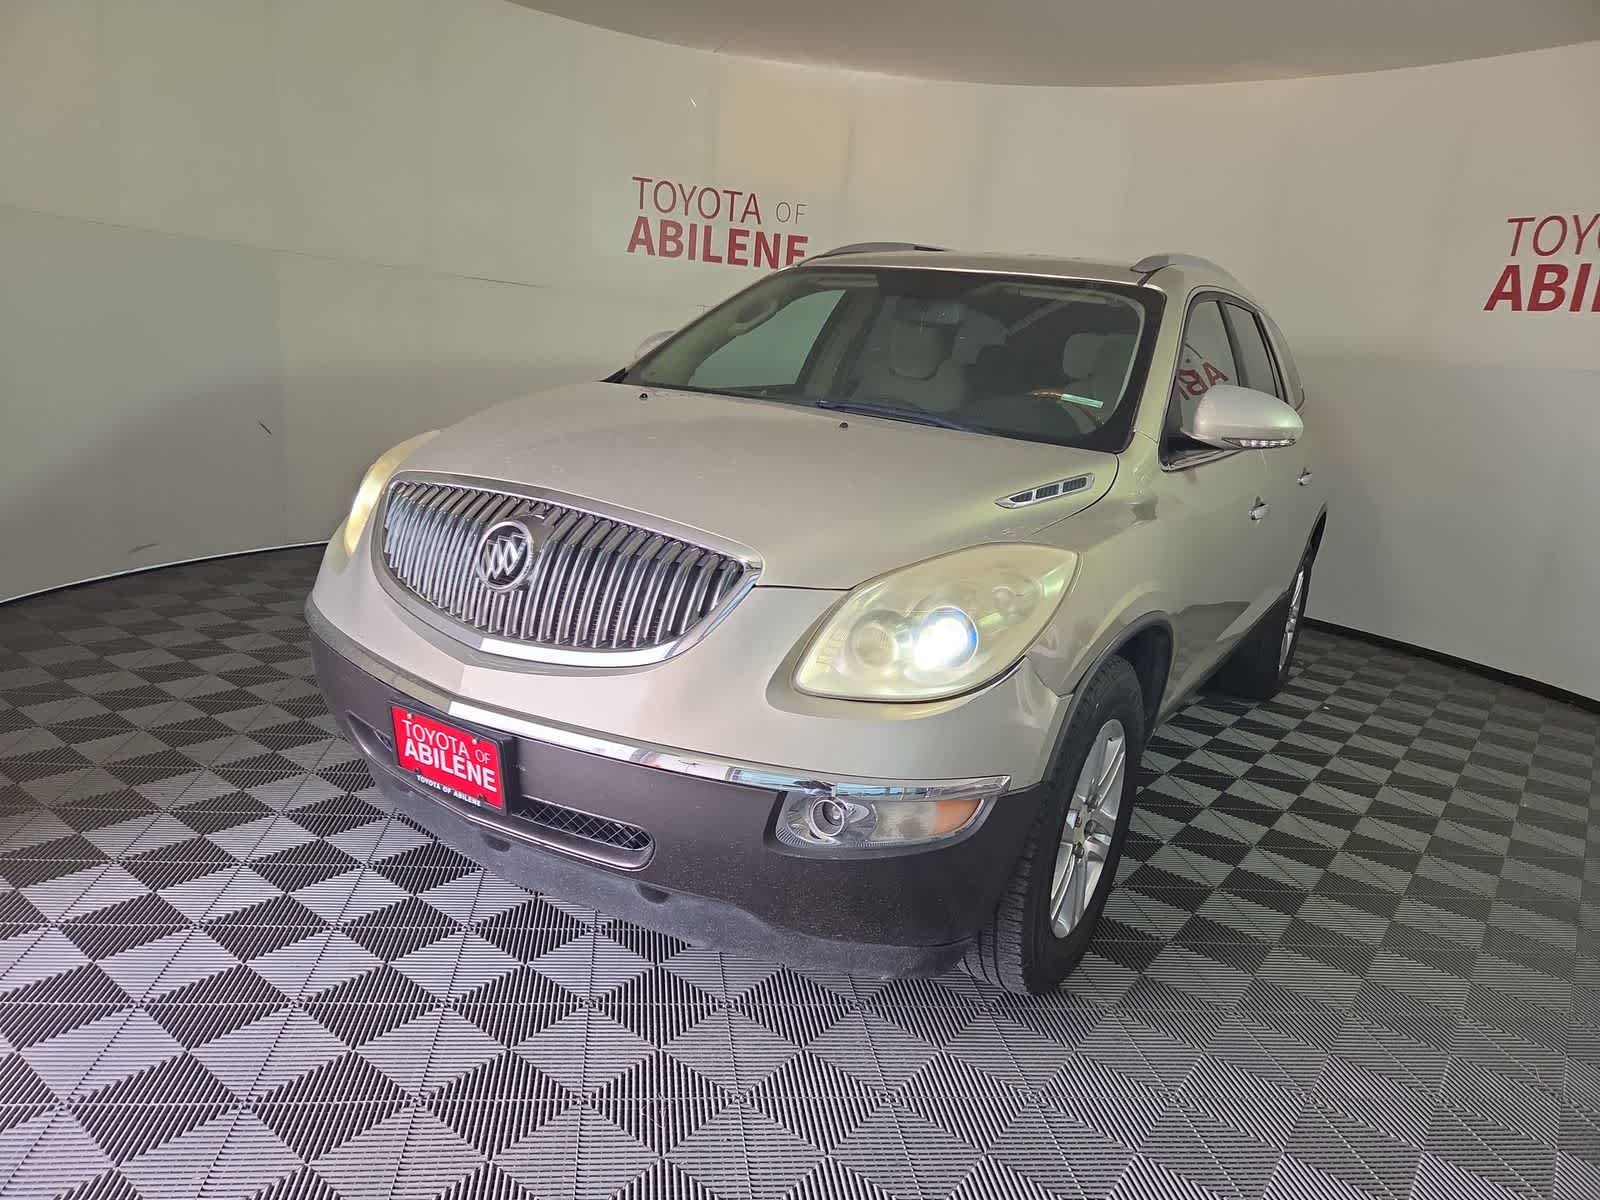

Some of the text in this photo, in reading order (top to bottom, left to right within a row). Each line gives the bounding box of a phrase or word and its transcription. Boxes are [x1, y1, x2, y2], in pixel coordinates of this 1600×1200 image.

[632, 176, 808, 225] TOYOTA OF
[1507, 213, 1600, 257] TOY
[402, 719, 491, 764] TOYOTA OF
[404, 738, 497, 793] ABILENE
[416, 774, 481, 807] TOYOTA OF ABILENE
